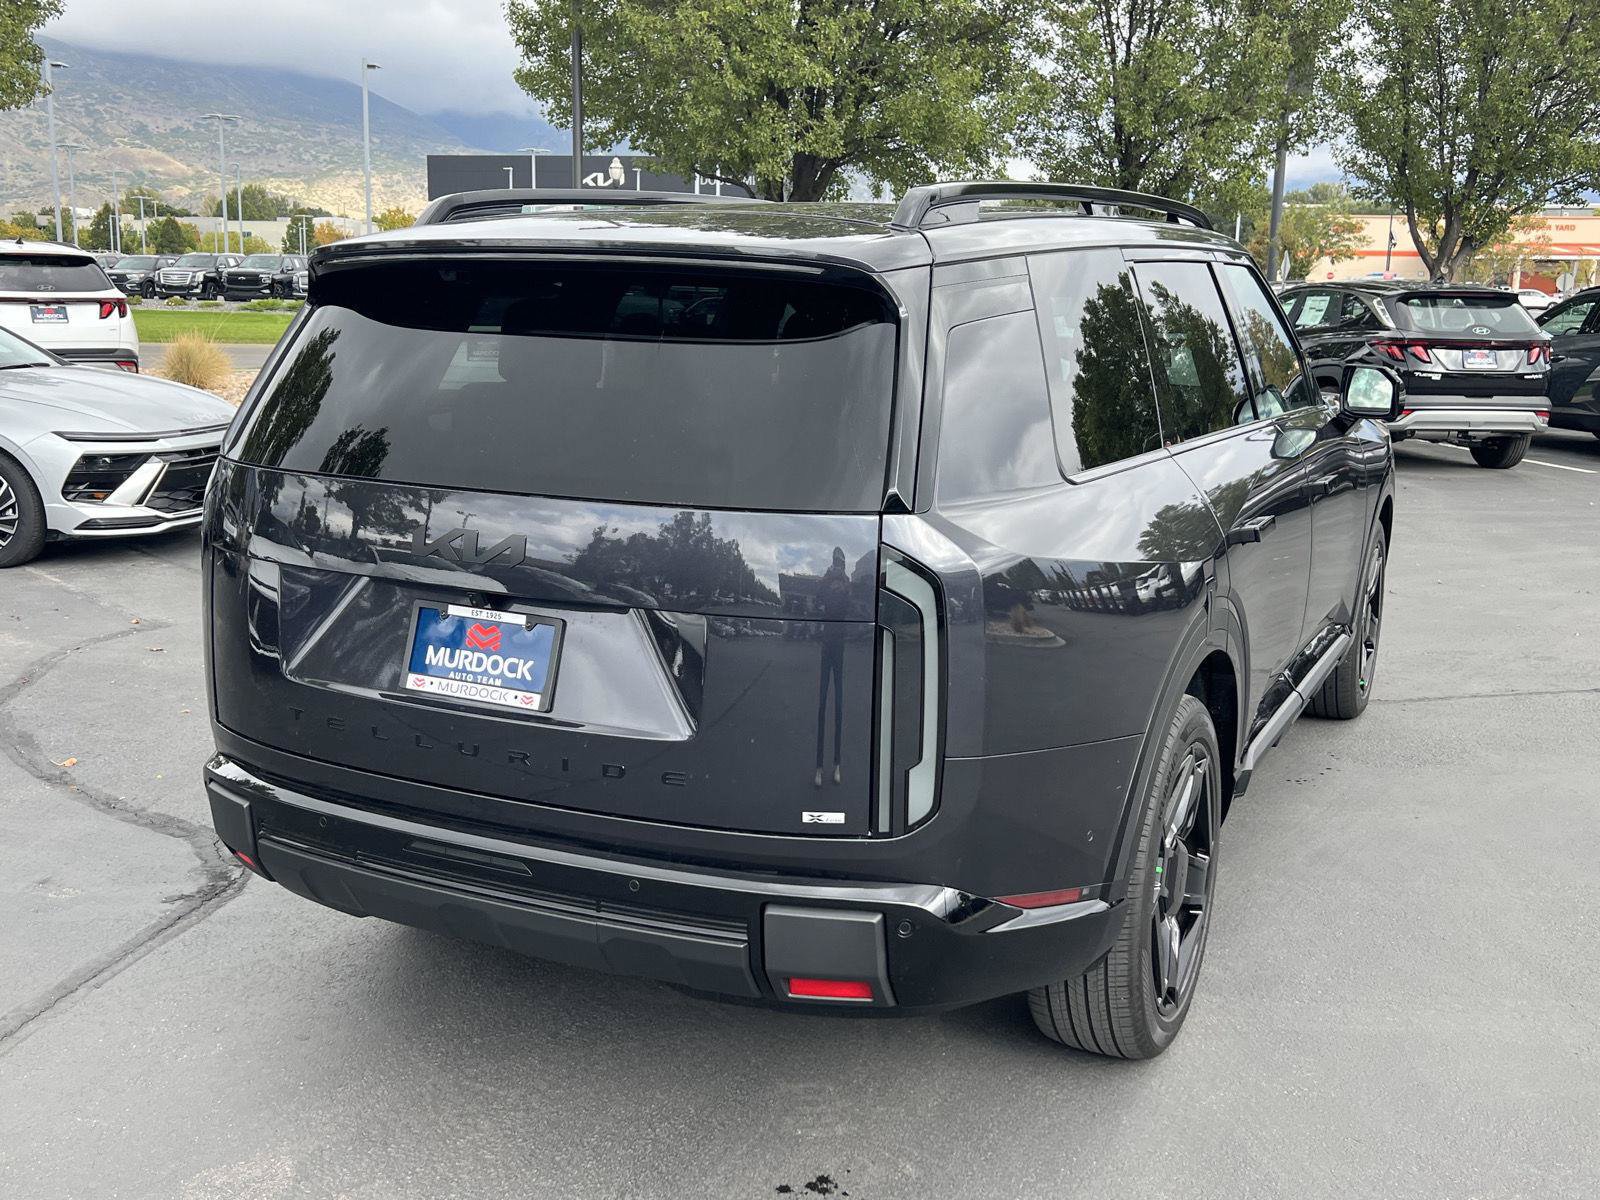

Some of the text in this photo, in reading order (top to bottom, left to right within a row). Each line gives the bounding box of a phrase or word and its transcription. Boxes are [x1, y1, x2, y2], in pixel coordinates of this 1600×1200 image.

[1555, 224, 1577, 232] YARD
[411, 524, 528, 569] KIA
[471, 609, 502, 620] EST 1925
[425, 644, 535, 681] MURDOCK
[449, 671, 502, 687] AUTO TEAM
[437, 681, 510, 702] MURDOCK
[289, 706, 688, 787] TELLURIDE
